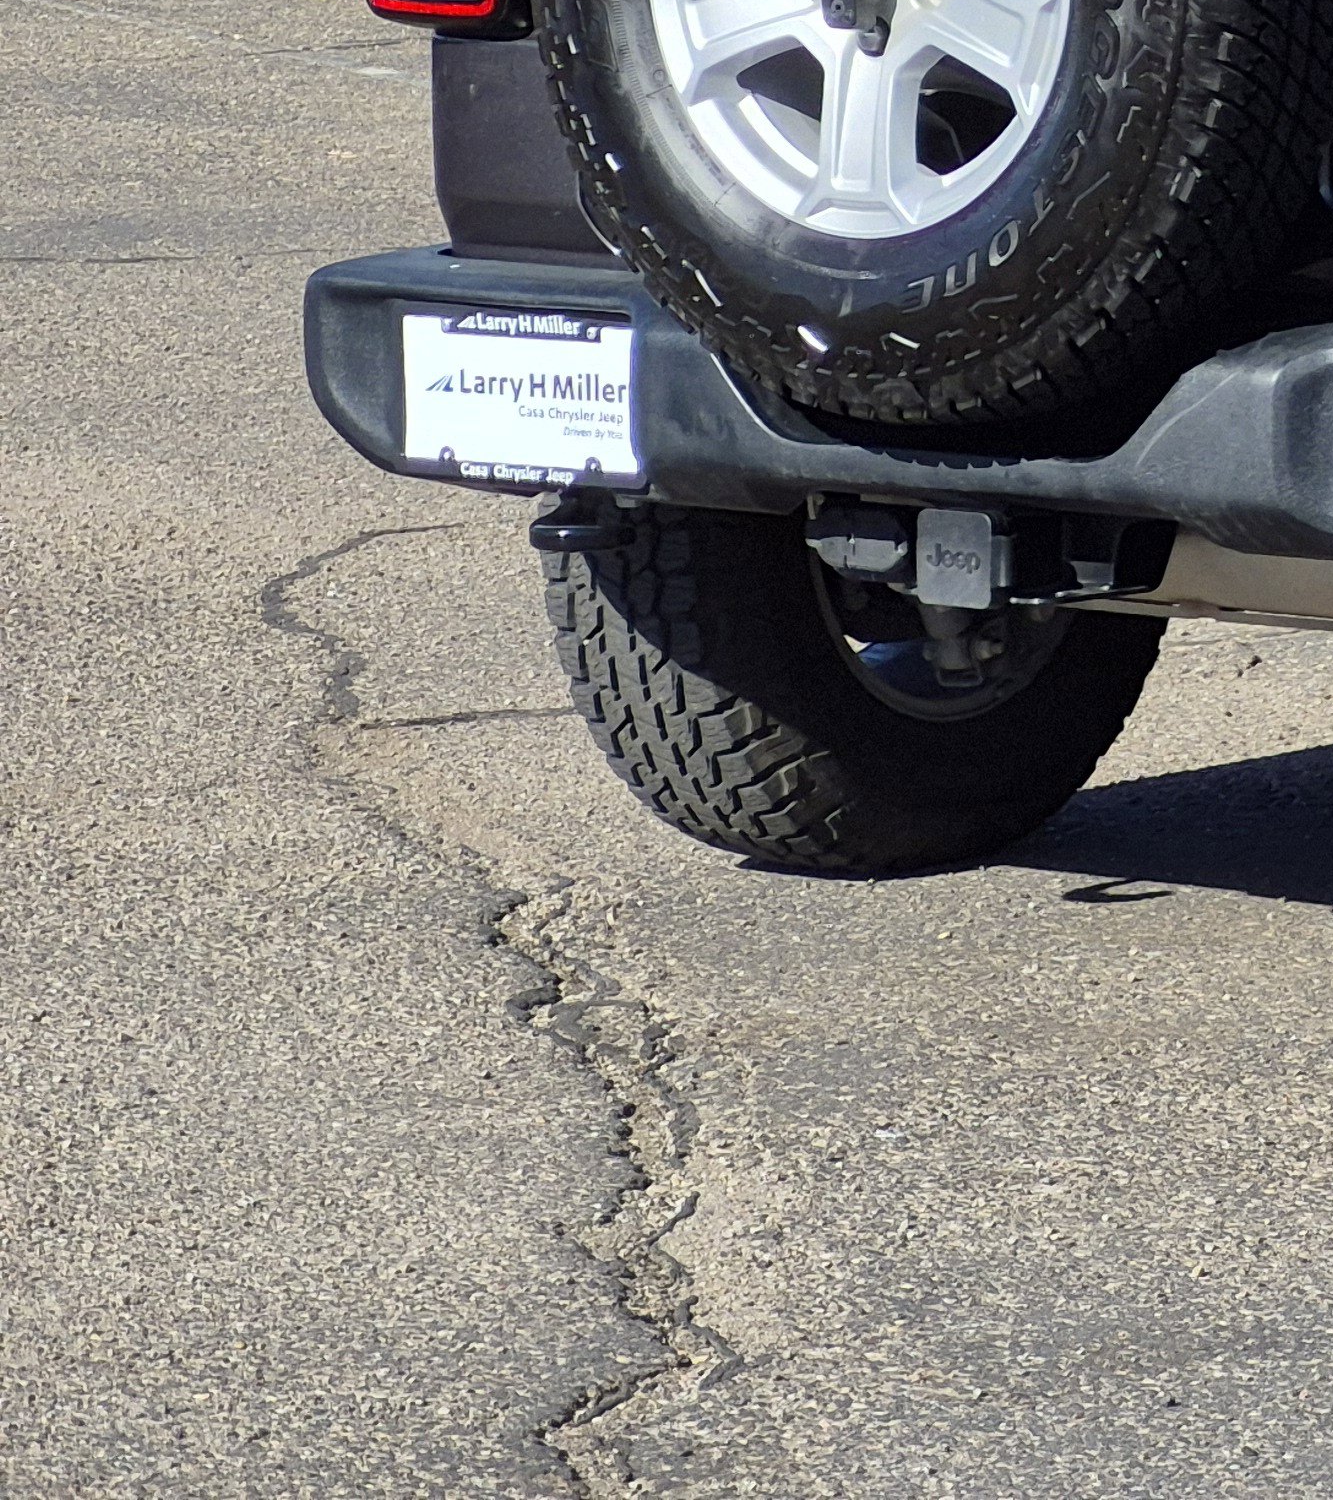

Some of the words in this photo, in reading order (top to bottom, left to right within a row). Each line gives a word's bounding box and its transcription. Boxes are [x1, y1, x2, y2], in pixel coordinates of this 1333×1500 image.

[476, 312, 517, 336] Larry
[518, 314, 533, 333] H
[534, 314, 582, 336] Miller
[460, 368, 524, 403] Larry
[529, 373, 546, 399] H
[552, 373, 627, 404] Miller
[518, 405, 545, 419] Casa
[548, 407, 595, 424] Chrysler
[598, 411, 624, 427] Jeep
[460, 462, 488, 480] Casa
[493, 463, 543, 484] Chrysler
[545, 467, 575, 487] Jeep
[927, 543, 980, 574] Jeep
